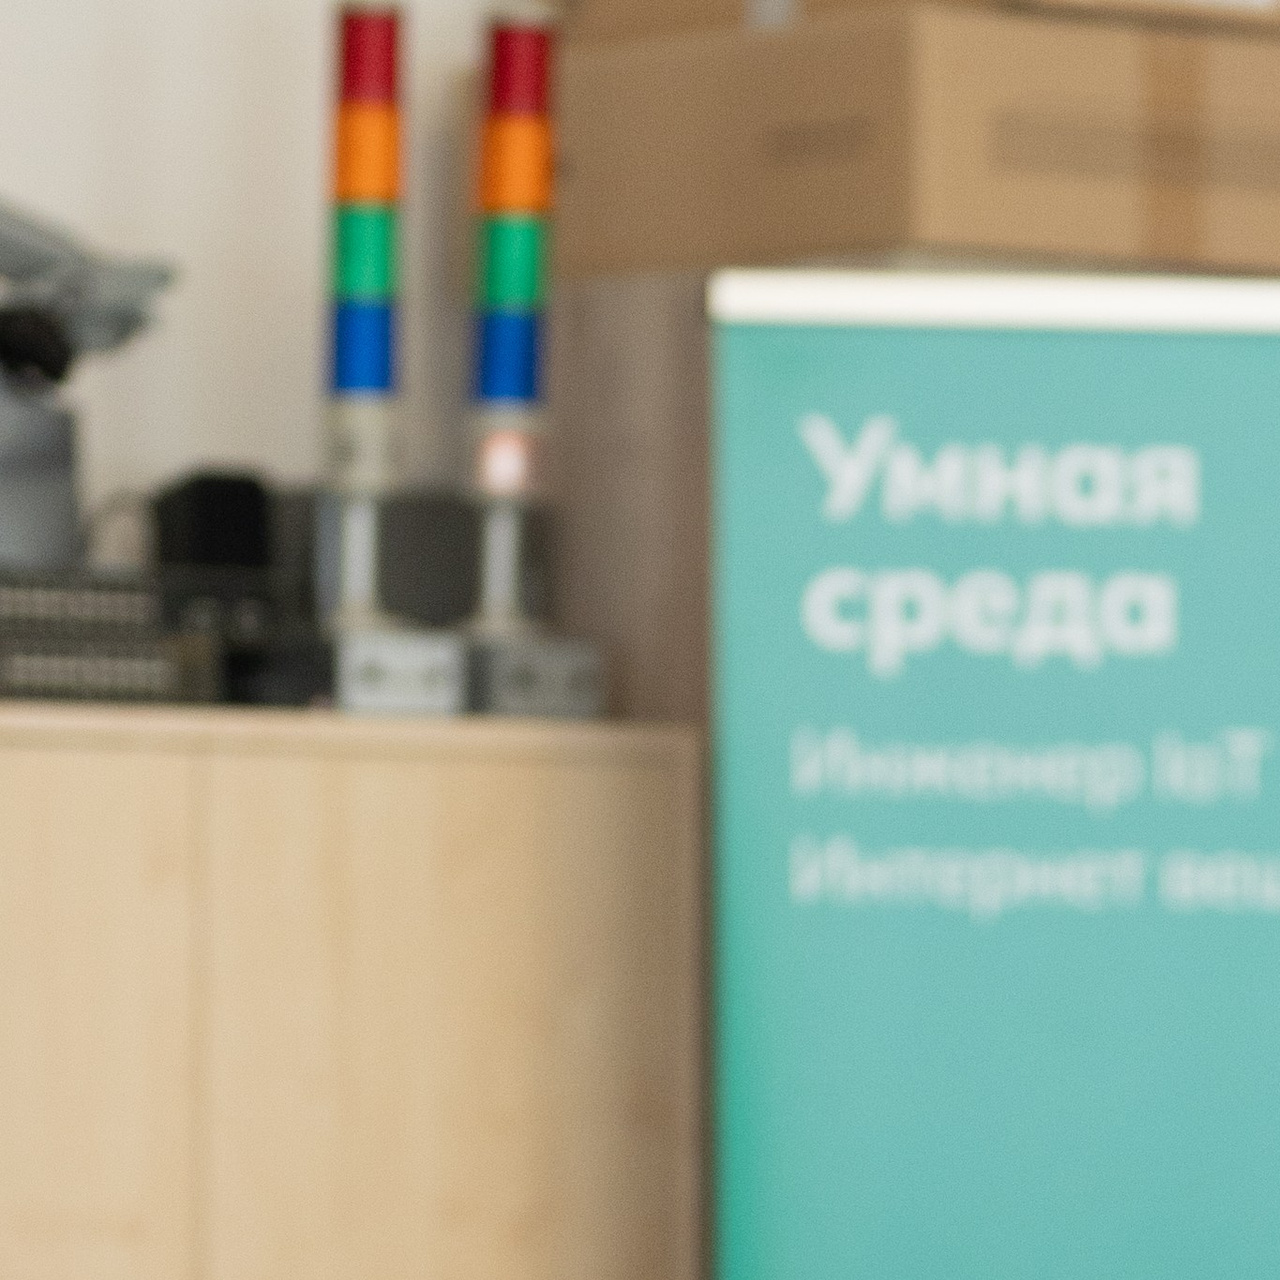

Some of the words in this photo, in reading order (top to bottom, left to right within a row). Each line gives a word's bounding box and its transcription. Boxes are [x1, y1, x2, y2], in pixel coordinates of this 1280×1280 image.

[799, 413, 1199, 526] Умная
[803, 568, 1178, 674] среда
[790, 835, 1147, 916] Интернет
